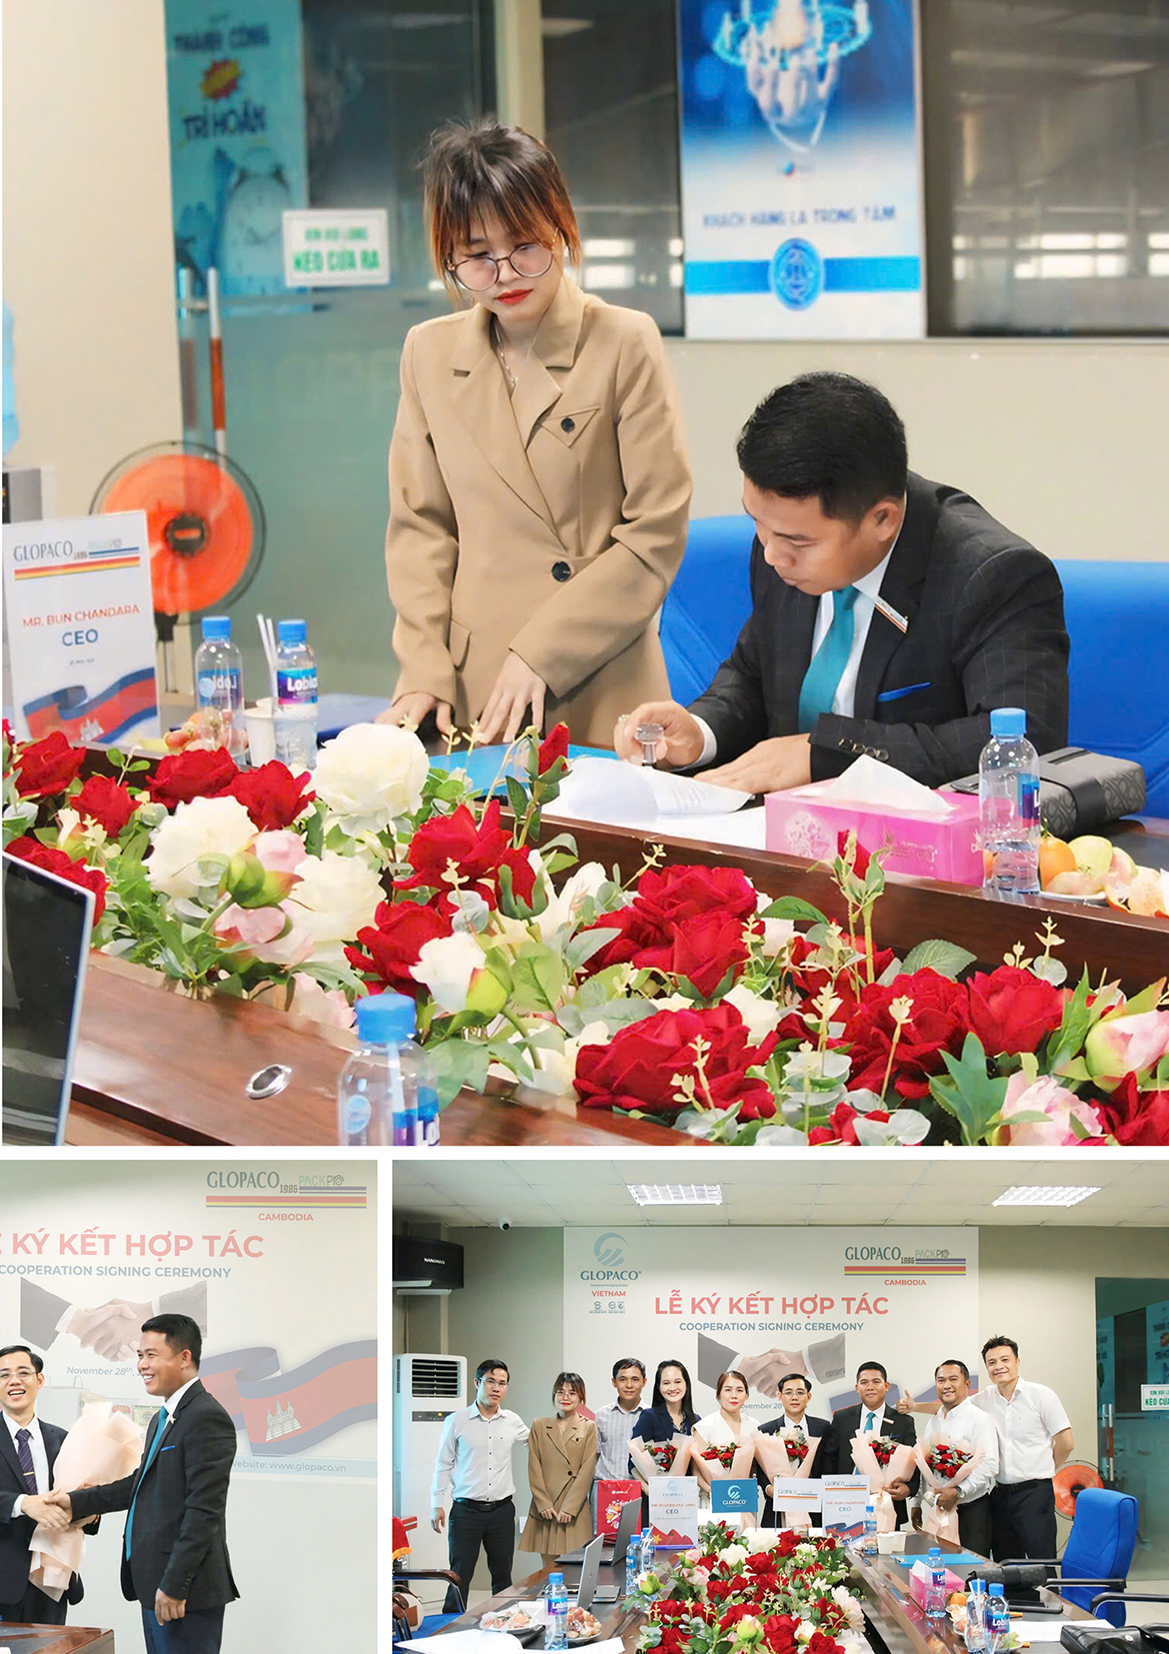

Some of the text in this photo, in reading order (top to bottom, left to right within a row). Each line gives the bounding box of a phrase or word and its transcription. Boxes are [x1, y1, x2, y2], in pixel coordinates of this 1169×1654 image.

[14, 540, 73, 562] GLOPACO
[47, 612, 72, 625] BUN
[74, 604, 140, 622] CHANDARA
[62, 628, 98, 646] CEO
[206, 1171, 280, 1188] GLOPACO
[280, 1184, 298, 1193] 1986
[258, 1213, 314, 1221] CAMBODIA
[12, 1228, 50, 1255] KÝ
[59, 1226, 116, 1255] KẾT
[126, 1230, 193, 1262] HỢP
[202, 1229, 264, 1258] TÁC
[845, 1246, 901, 1260] GLOPACO
[96, 1266, 151, 1276] SIGNING
[155, 1267, 231, 1278] CEREMONY
[655, 1289, 889, 1319] LỄ KÝ KẾT HỢP TÁC
[679, 1322, 864, 1331] COOPERATION SIGNING CEREMONY
[67, 1366, 113, 1375] November
[269, 1461, 347, 1472] www.glopaco.vn
